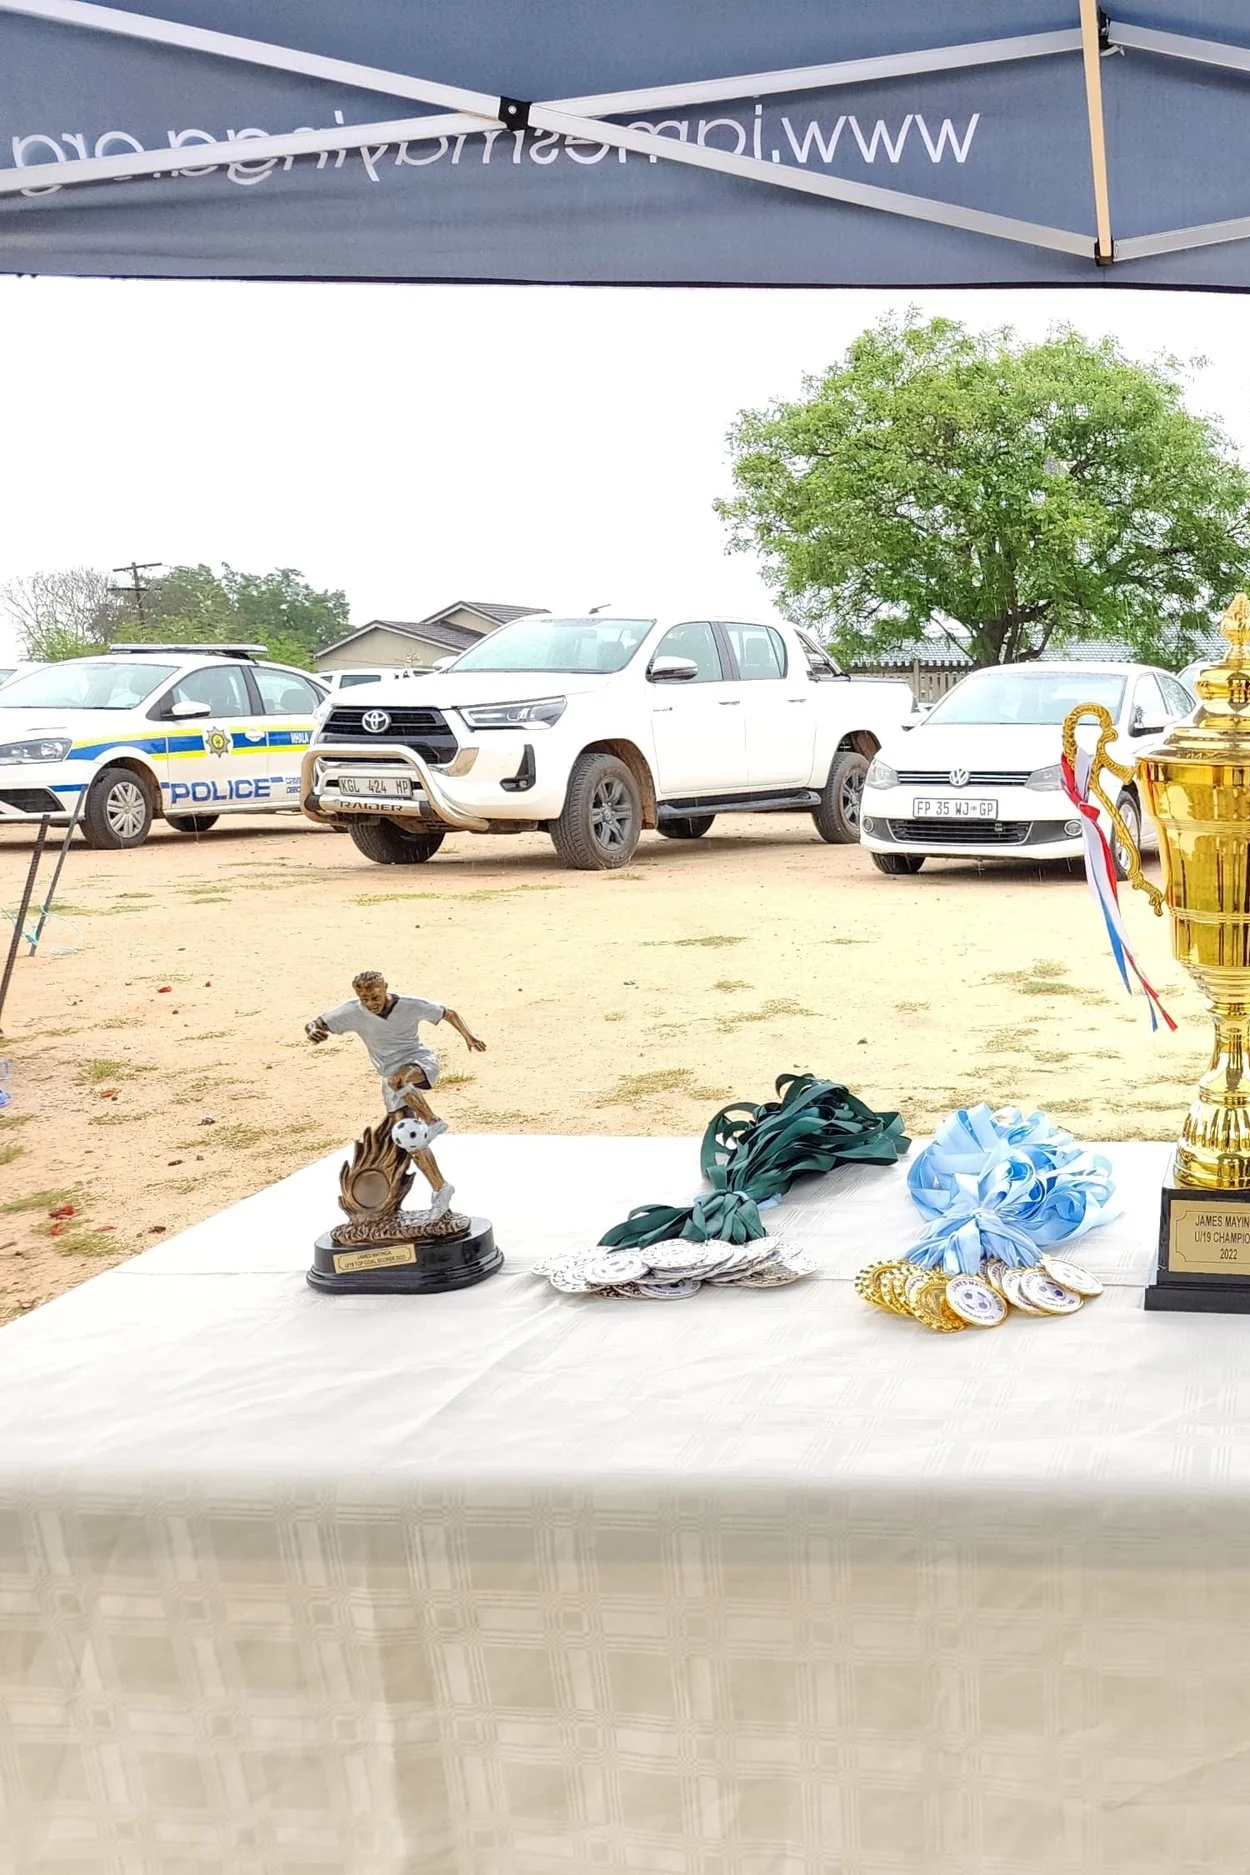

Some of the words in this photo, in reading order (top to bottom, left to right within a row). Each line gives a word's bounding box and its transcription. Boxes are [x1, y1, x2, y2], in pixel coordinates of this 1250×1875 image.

[171, 777, 271, 804] POLICE
[341, 779, 360, 793] KGL
[368, 780, 387, 793] 424
[340, 800, 403, 812] RAIDER
[917, 801, 930, 815] FP
[936, 801, 949, 815] 35
[955, 802, 969, 815] WJ
[979, 802, 993, 816] GP
[1195, 1214, 1223, 1227] JAMES
[1194, 1231, 1211, 1243] U/19
[1220, 1248, 1238, 1260] 2022
